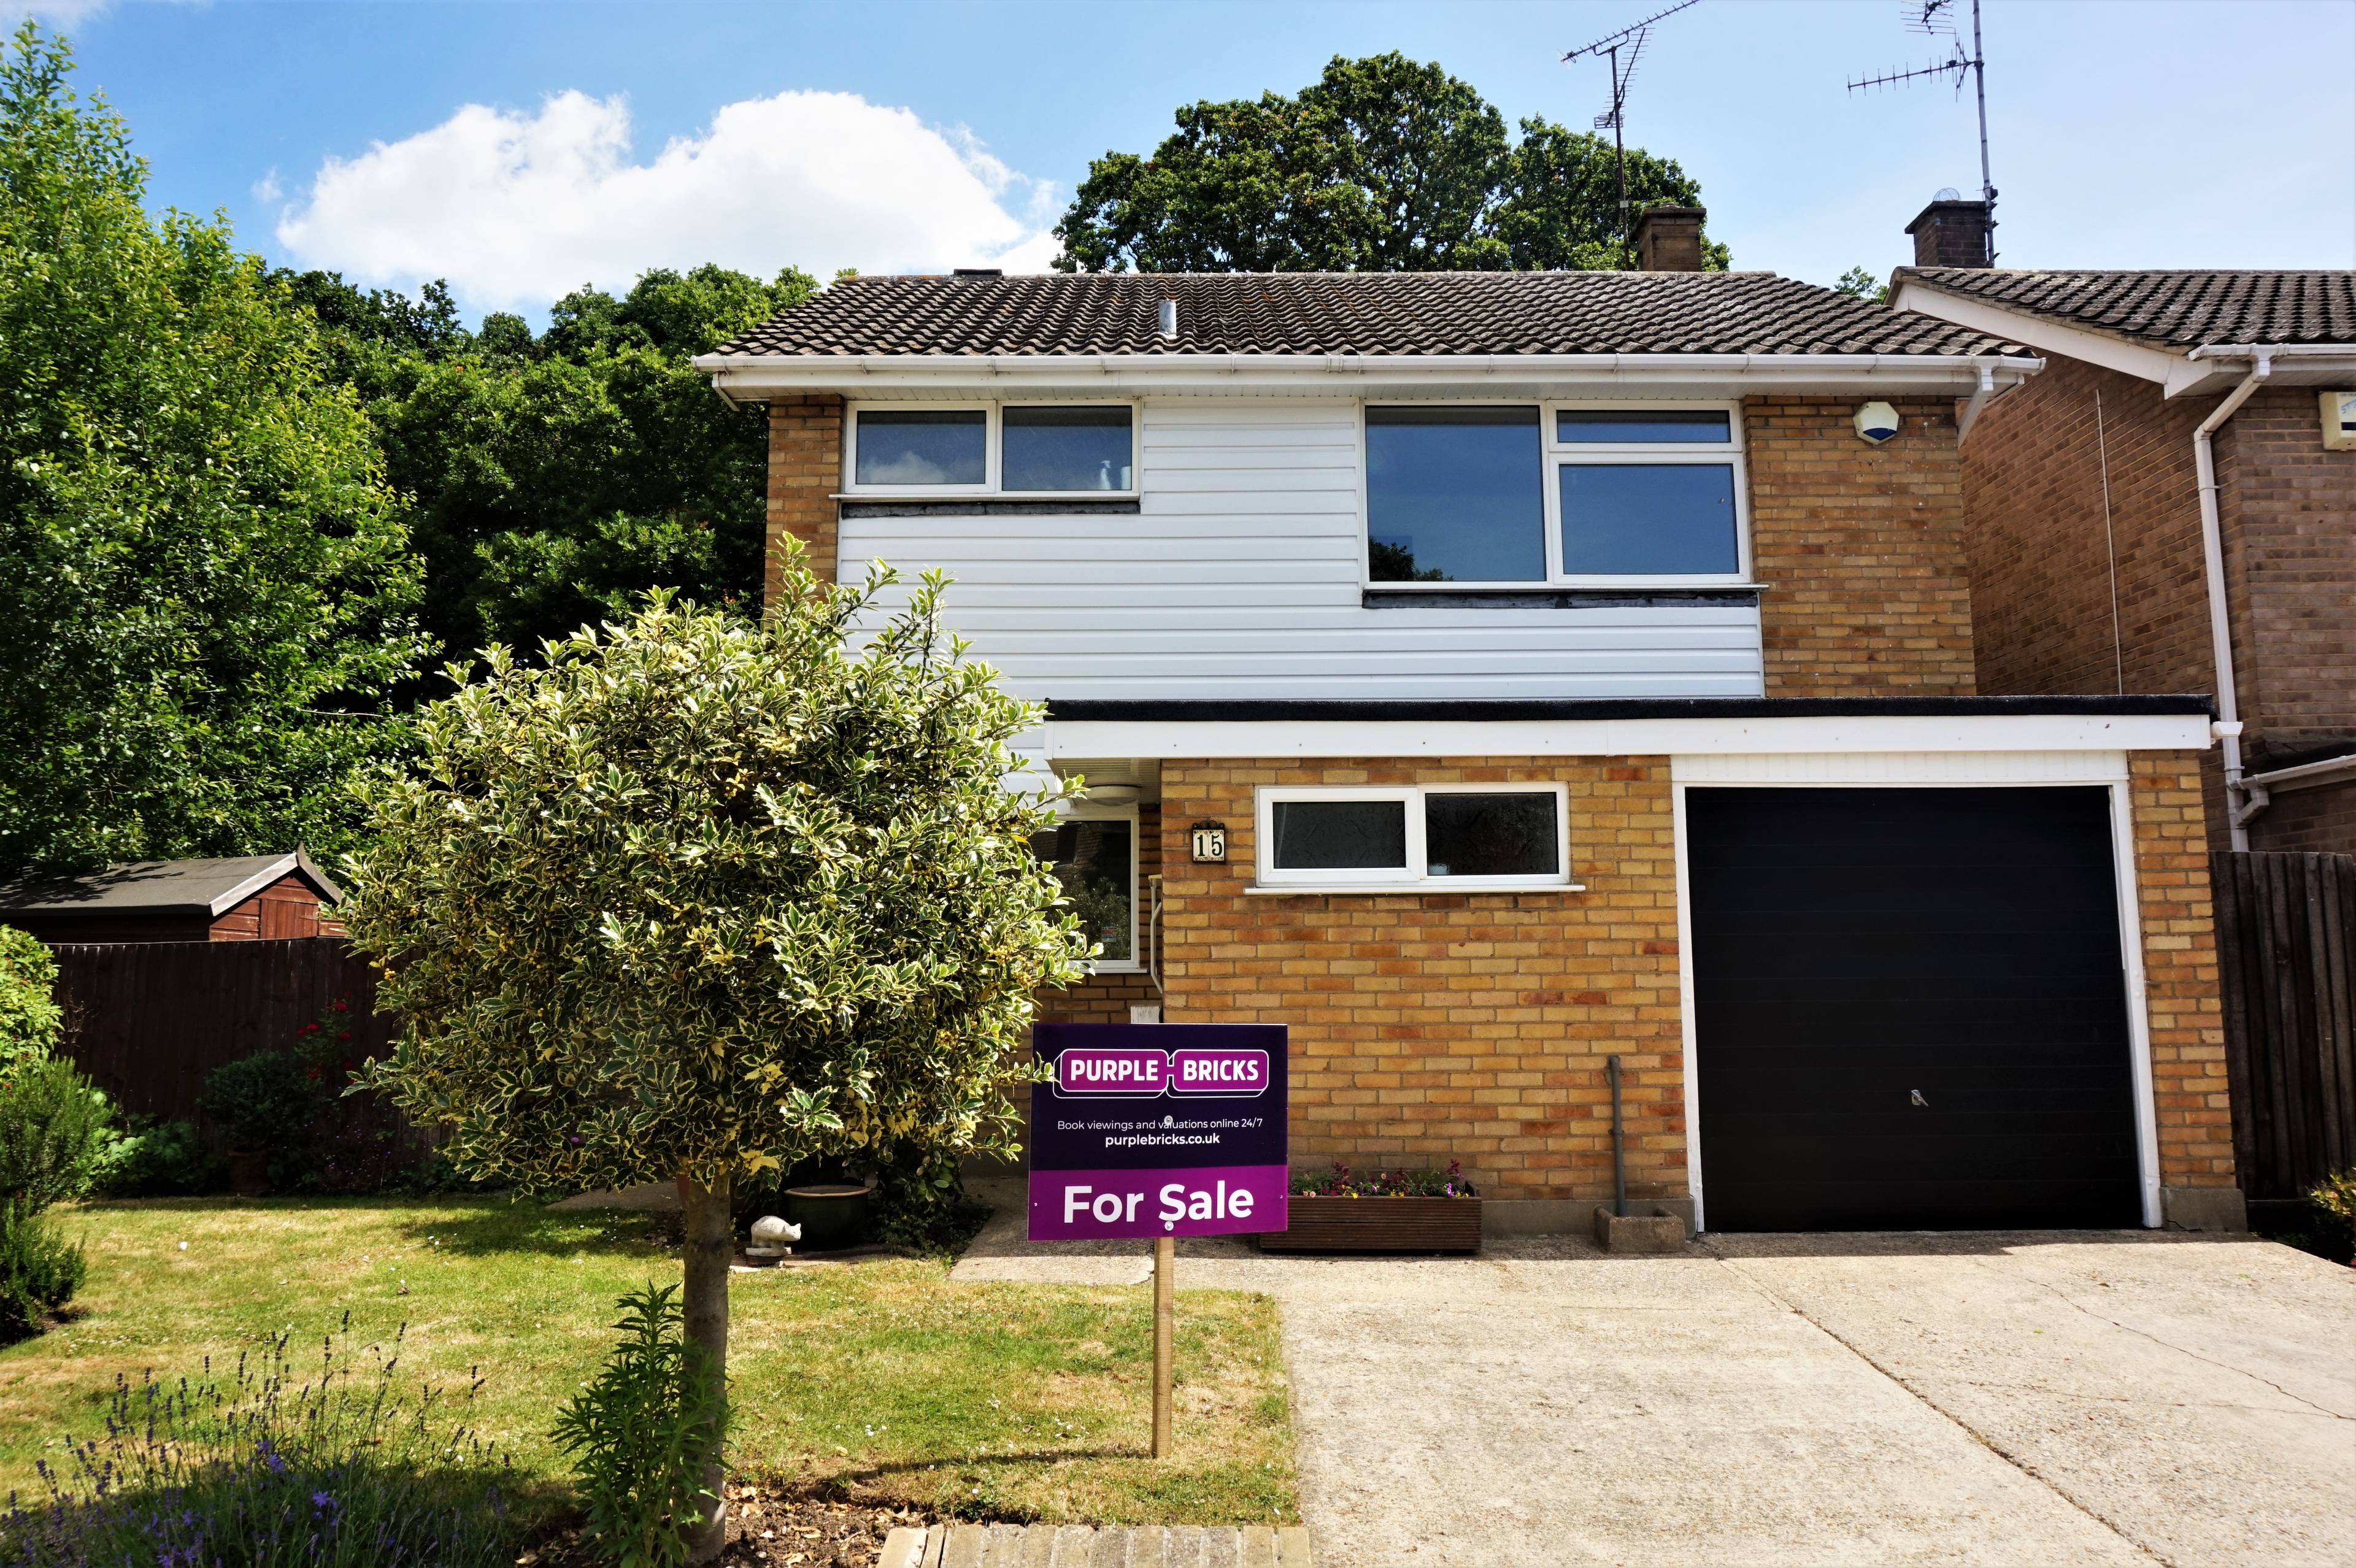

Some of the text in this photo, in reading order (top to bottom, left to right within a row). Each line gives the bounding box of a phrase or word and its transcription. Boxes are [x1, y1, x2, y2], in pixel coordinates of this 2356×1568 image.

[1197, 834, 1222, 856] 15
[1070, 1059, 1259, 1082] PURPLE BRICKS
[1057, 1120, 1085, 1130] Book
[1087, 1120, 1133, 1131] viewings
[1136, 1120, 1155, 1129] and
[1210, 1118, 1239, 1128] online
[1241, 1117, 1263, 1128] 24/7
[1105, 1132, 1220, 1148] purplebricks.co.uk
[1063, 1180, 1254, 1223] For Sale
